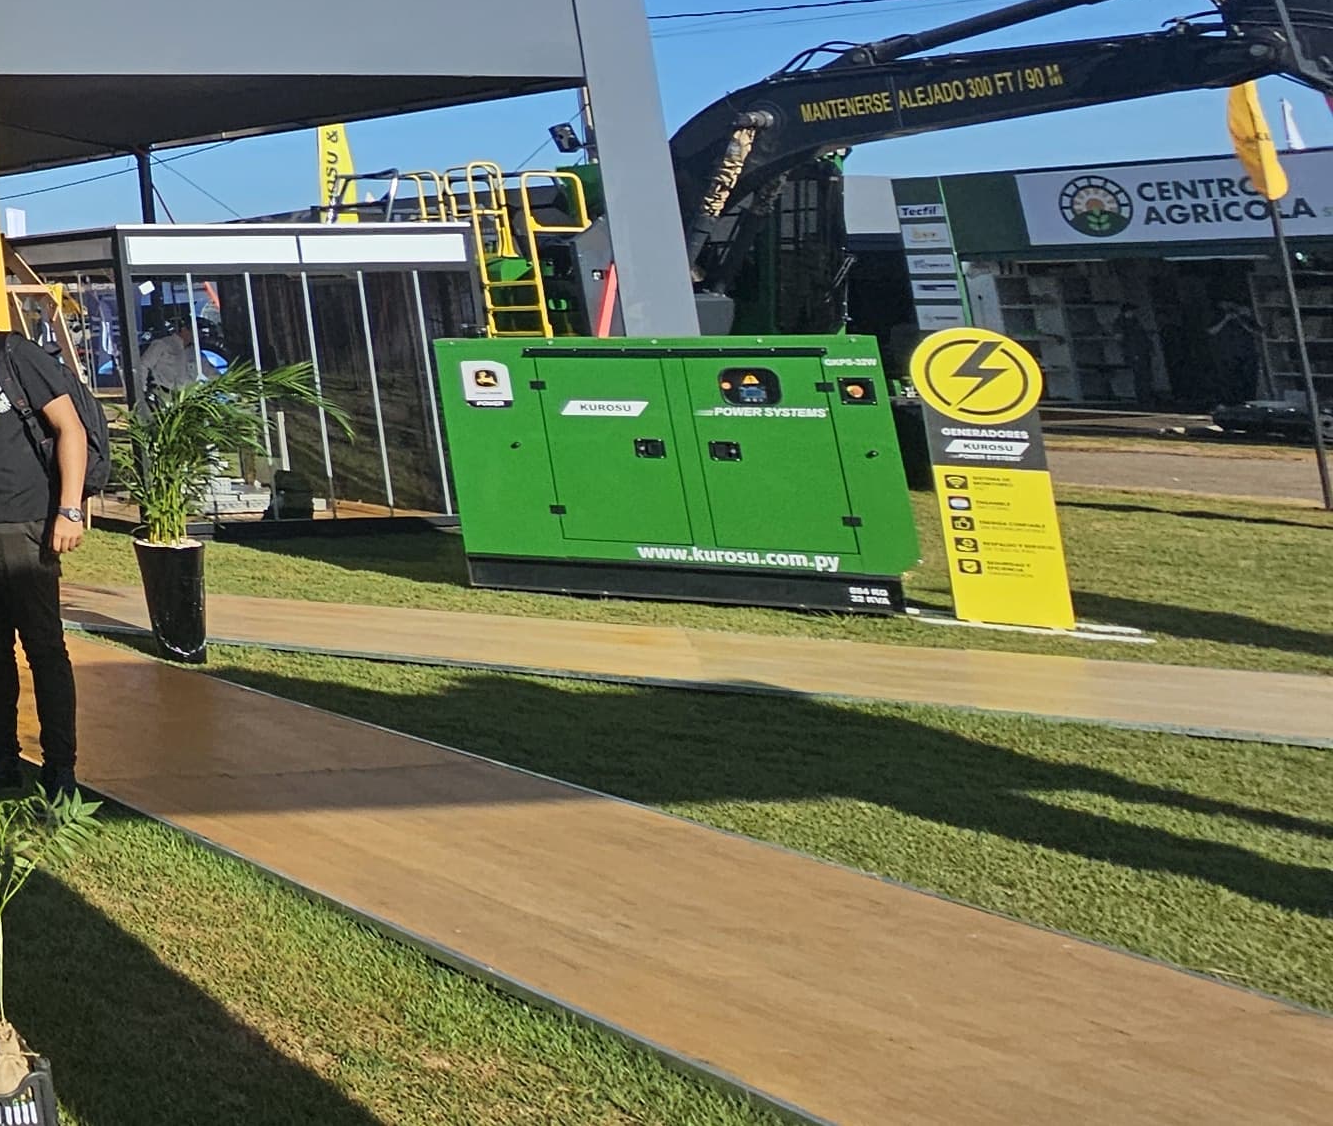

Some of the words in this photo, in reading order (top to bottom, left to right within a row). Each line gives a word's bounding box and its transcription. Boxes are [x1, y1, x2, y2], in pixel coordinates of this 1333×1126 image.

[800, 94, 894, 123] MANTENERSE
[898, 80, 966, 110] ALEJADO
[967, 74, 993, 99] 300
[995, 70, 1016, 95] FT
[1026, 68, 1045, 90] 90
[1046, 64, 1064, 87] M
[901, 206, 937, 216] Tecfil
[579, 403, 633, 412] KUROSU
[714, 407, 765, 418] POWER
[940, 427, 1030, 440] GENERADORES
[963, 442, 1014, 452] KUROSU
[637, 546, 840, 573] www.kurosu.com.py
